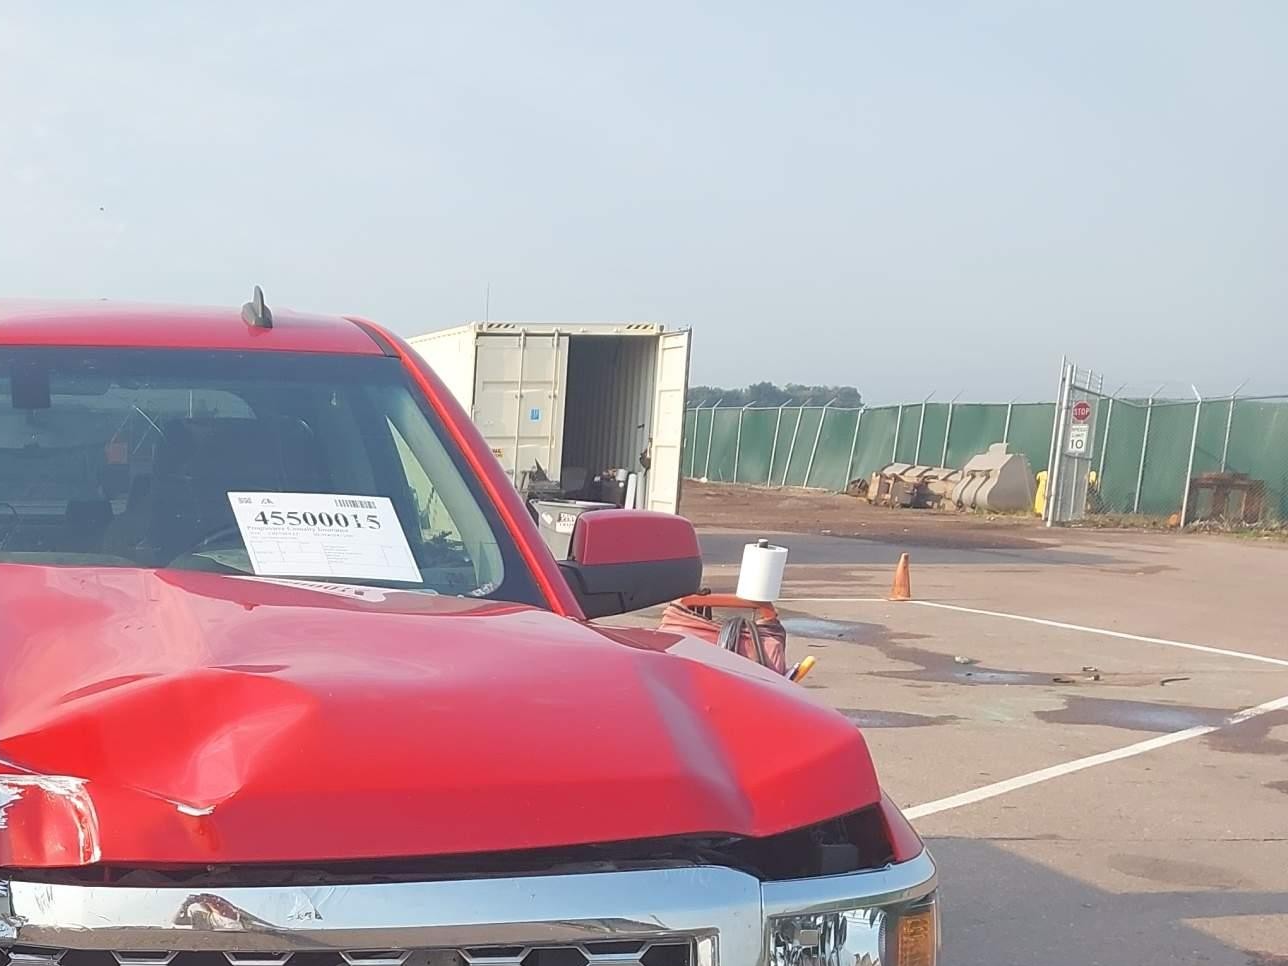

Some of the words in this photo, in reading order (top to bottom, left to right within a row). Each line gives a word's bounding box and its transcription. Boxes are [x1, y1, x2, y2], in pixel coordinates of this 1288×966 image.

[1074, 407, 1090, 416] STOP
[1070, 439, 1084, 449] 10
[254, 511, 381, 530] 45500015
